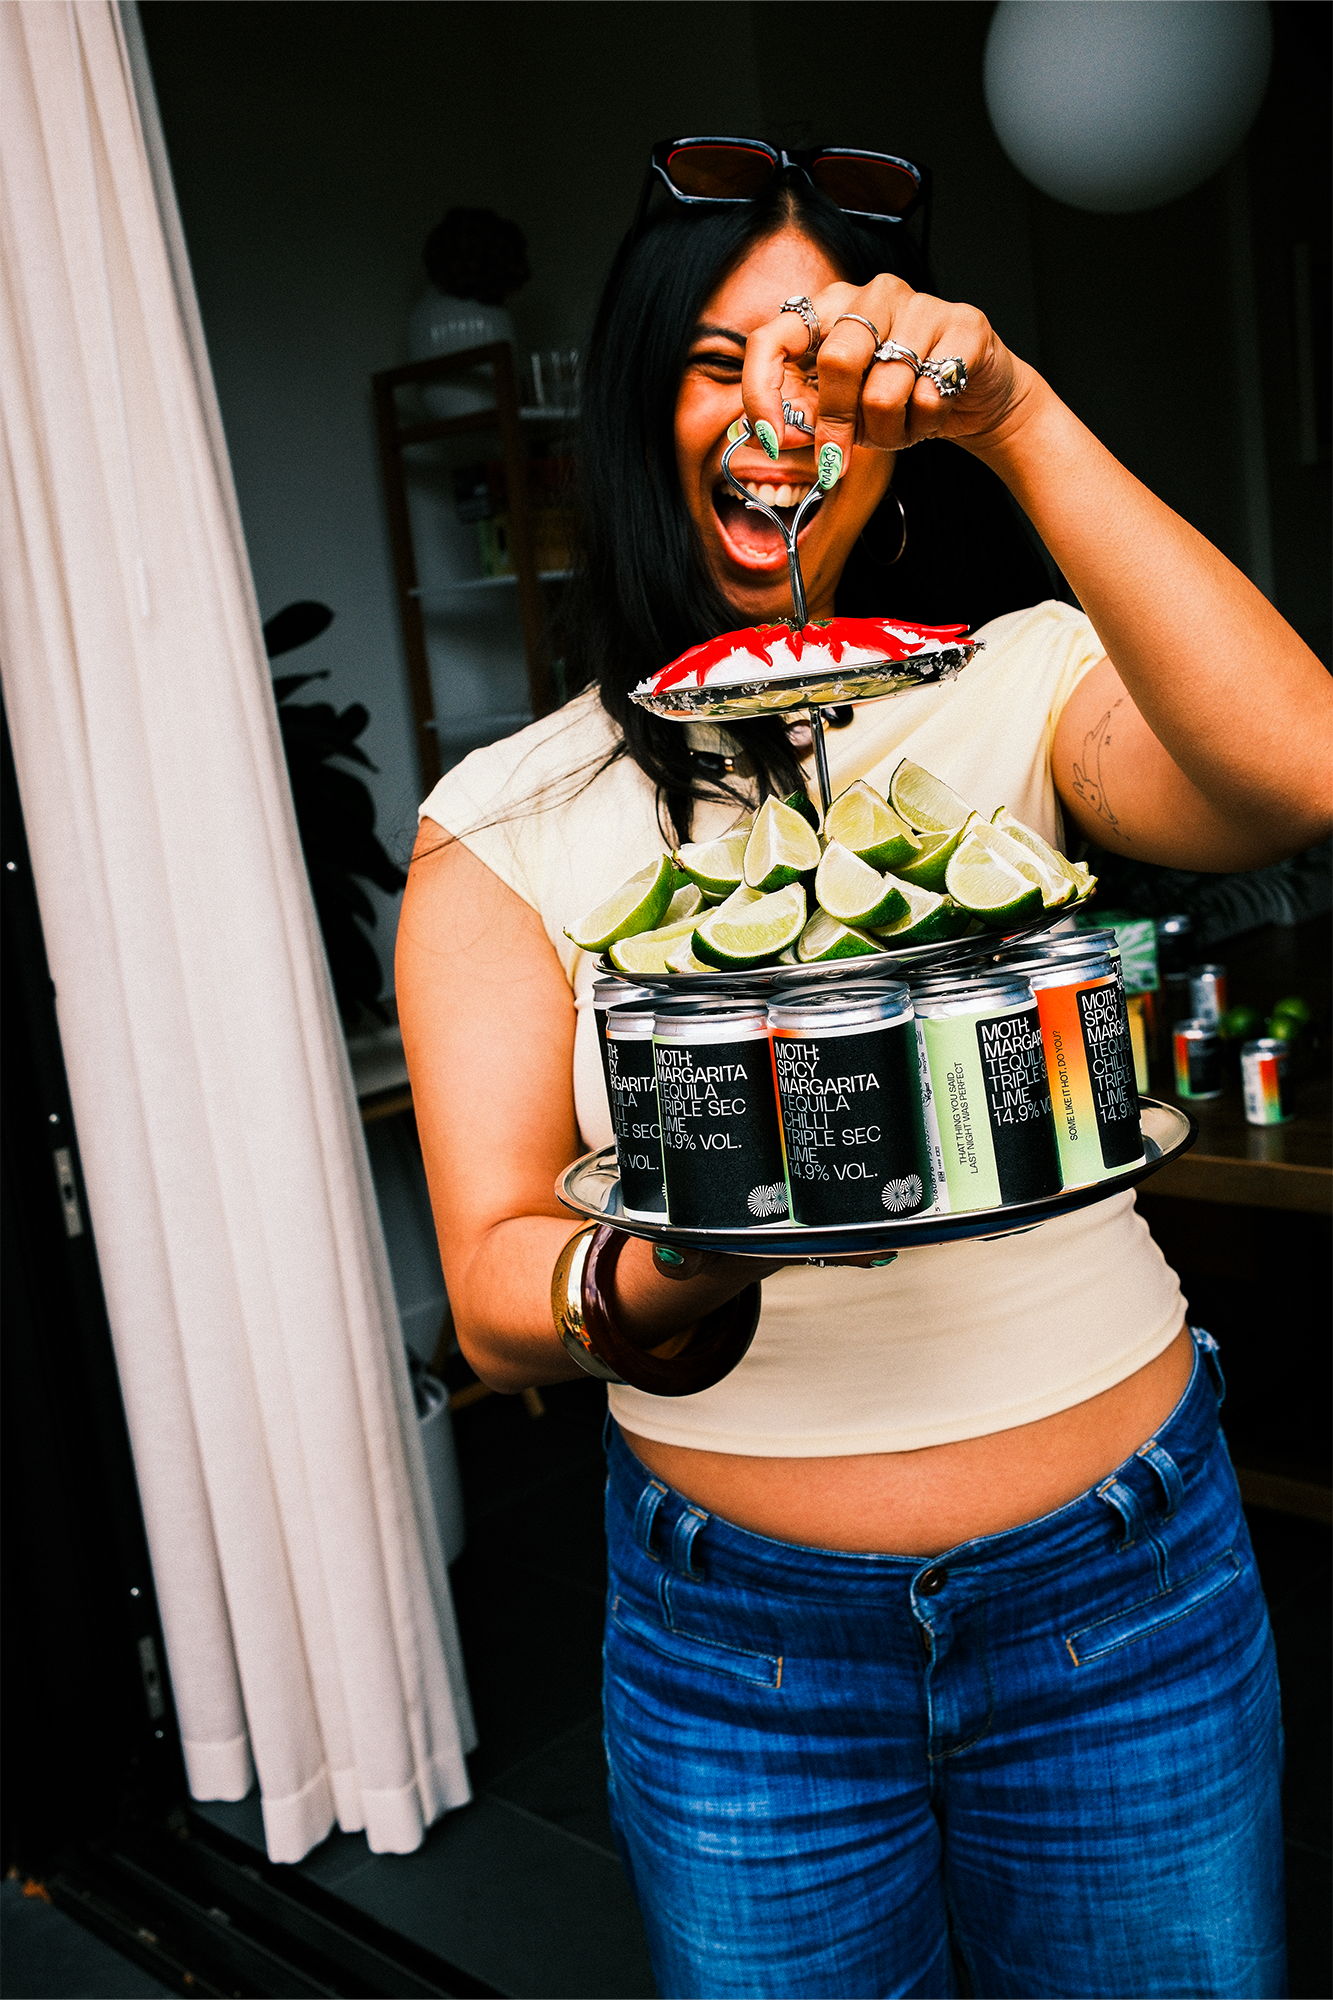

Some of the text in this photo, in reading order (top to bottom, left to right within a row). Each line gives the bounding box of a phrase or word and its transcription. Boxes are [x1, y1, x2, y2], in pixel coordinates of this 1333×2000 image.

[1084, 1004, 1117, 1027] SPICY
[981, 1016, 1030, 1042] MOTH:
[775, 1041, 820, 1061] MOTH:
[984, 1027, 1042, 1059] MARGAR
[1052, 1030, 1063, 1053] YOU?
[655, 1048, 693, 1067] MOTH:
[1056, 1053, 1066, 1067] DO
[657, 1064, 748, 1084] MARGARITA
[777, 1059, 818, 1078] SPICY
[988, 1066, 1041, 1092] TRIPLE
[1094, 1066, 1131, 1091] TRIPLE
[659, 1081, 719, 1101] TEQUILA
[779, 1073, 880, 1096] MARGARITA
[1062, 1088, 1070, 1097] IT
[781, 1093, 851, 1114] TEQUILA
[991, 1086, 1032, 1110] LIME
[1064, 1096, 1074, 1115] LIKE
[1097, 1085, 1128, 1108] LIME
[660, 1098, 703, 1117] TRIPLE
[708, 1098, 747, 1117] SEC
[954, 1062, 978, 1174] LAST NIGHT WAS PERFECT
[993, 1101, 1040, 1127] 14.9%
[661, 1114, 687, 1133] LIME
[783, 1110, 828, 1130] CHILLI
[947, 1072, 967, 1165] THAT THING YOU SAID
[1066, 1115, 1078, 1141] SOME
[699, 1132, 742, 1150] VOL.
[785, 1125, 881, 1147] TRIPLE SEC
[628, 1154, 660, 1170] VOL.
[787, 1143, 819, 1164] LIME
[789, 1162, 878, 1181] 14.9% VOL.
